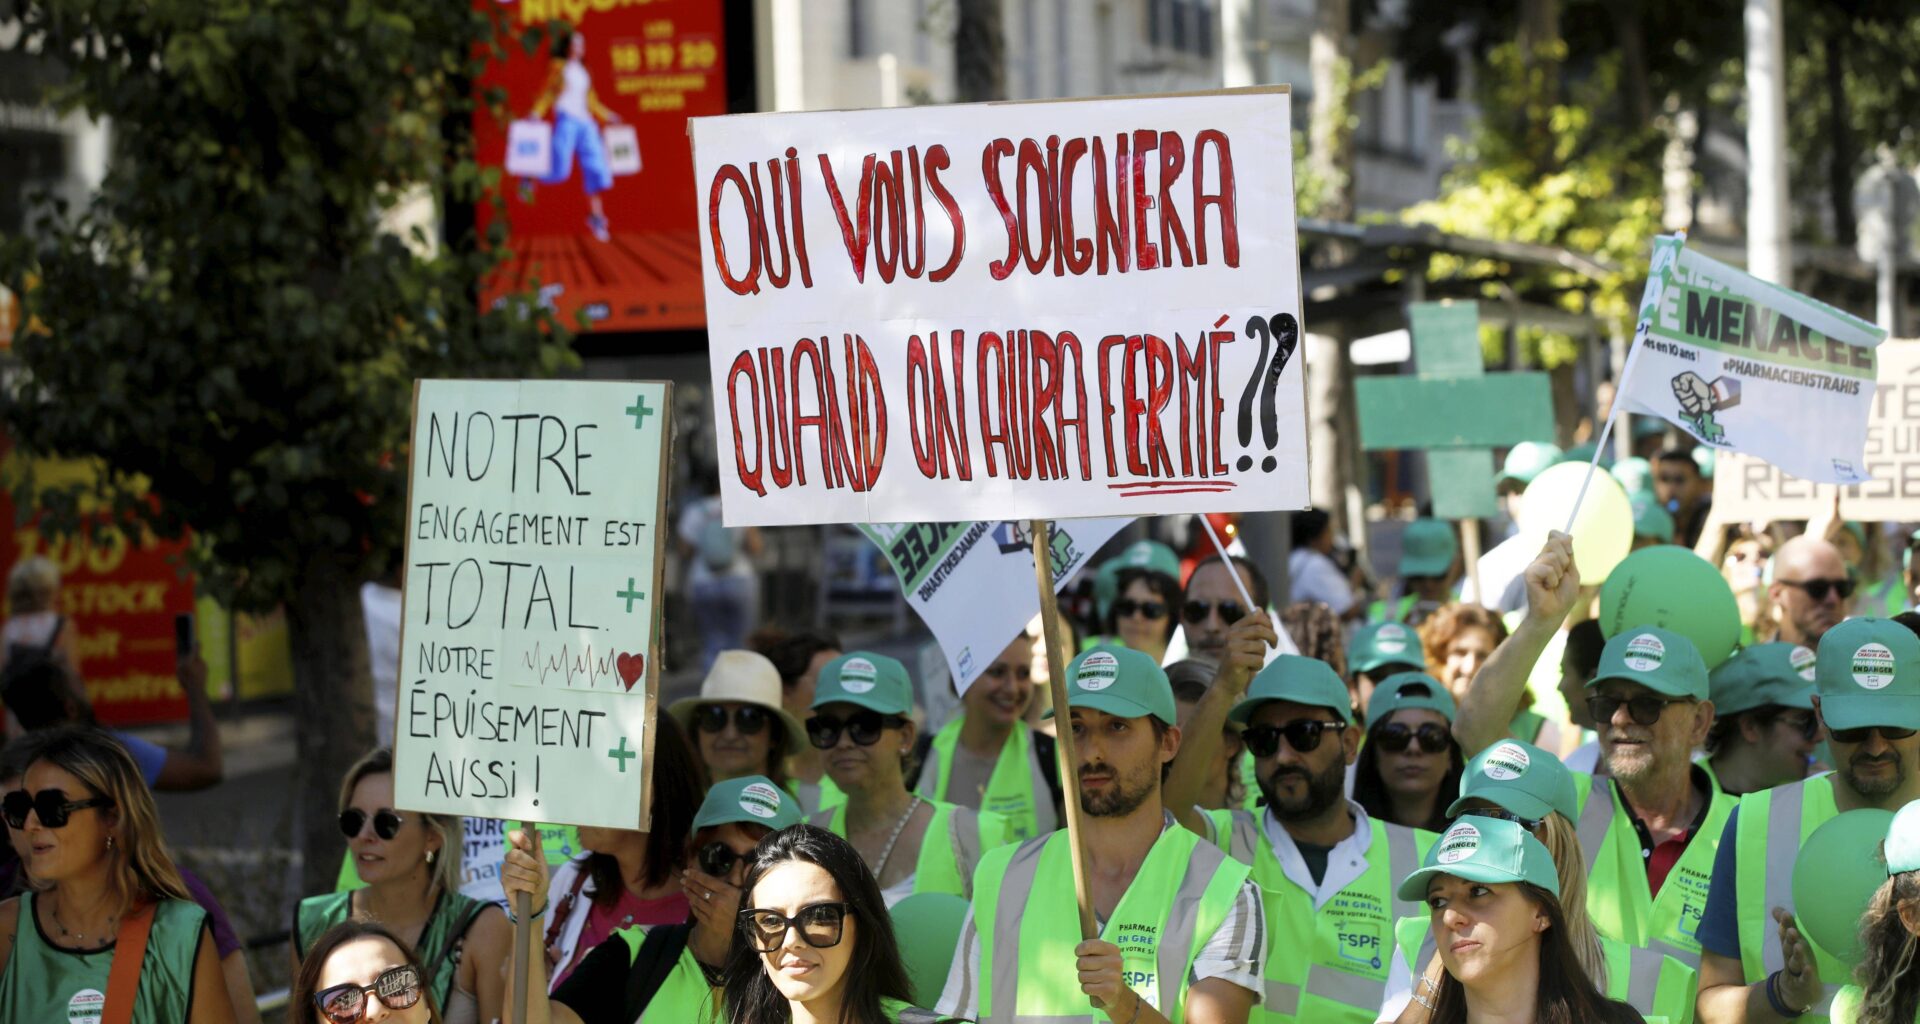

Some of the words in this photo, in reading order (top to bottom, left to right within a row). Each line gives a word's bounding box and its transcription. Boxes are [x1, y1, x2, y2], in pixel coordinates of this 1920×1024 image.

[818, 145, 966, 284] VOUS
[727, 334, 888, 498] QUAND
[907, 329, 973, 482] ON
[977, 329, 1092, 481] AURA
[427, 411, 598, 496] NOTRE
[417, 503, 589, 546] ENGAGEMENT
[604, 520, 647, 546] EST
[419, 641, 495, 680] NOTRE
[1335, 899, 1348, 907] EN
[1118, 935, 1128, 944] EN
[1338, 933, 1381, 949] FSPF
